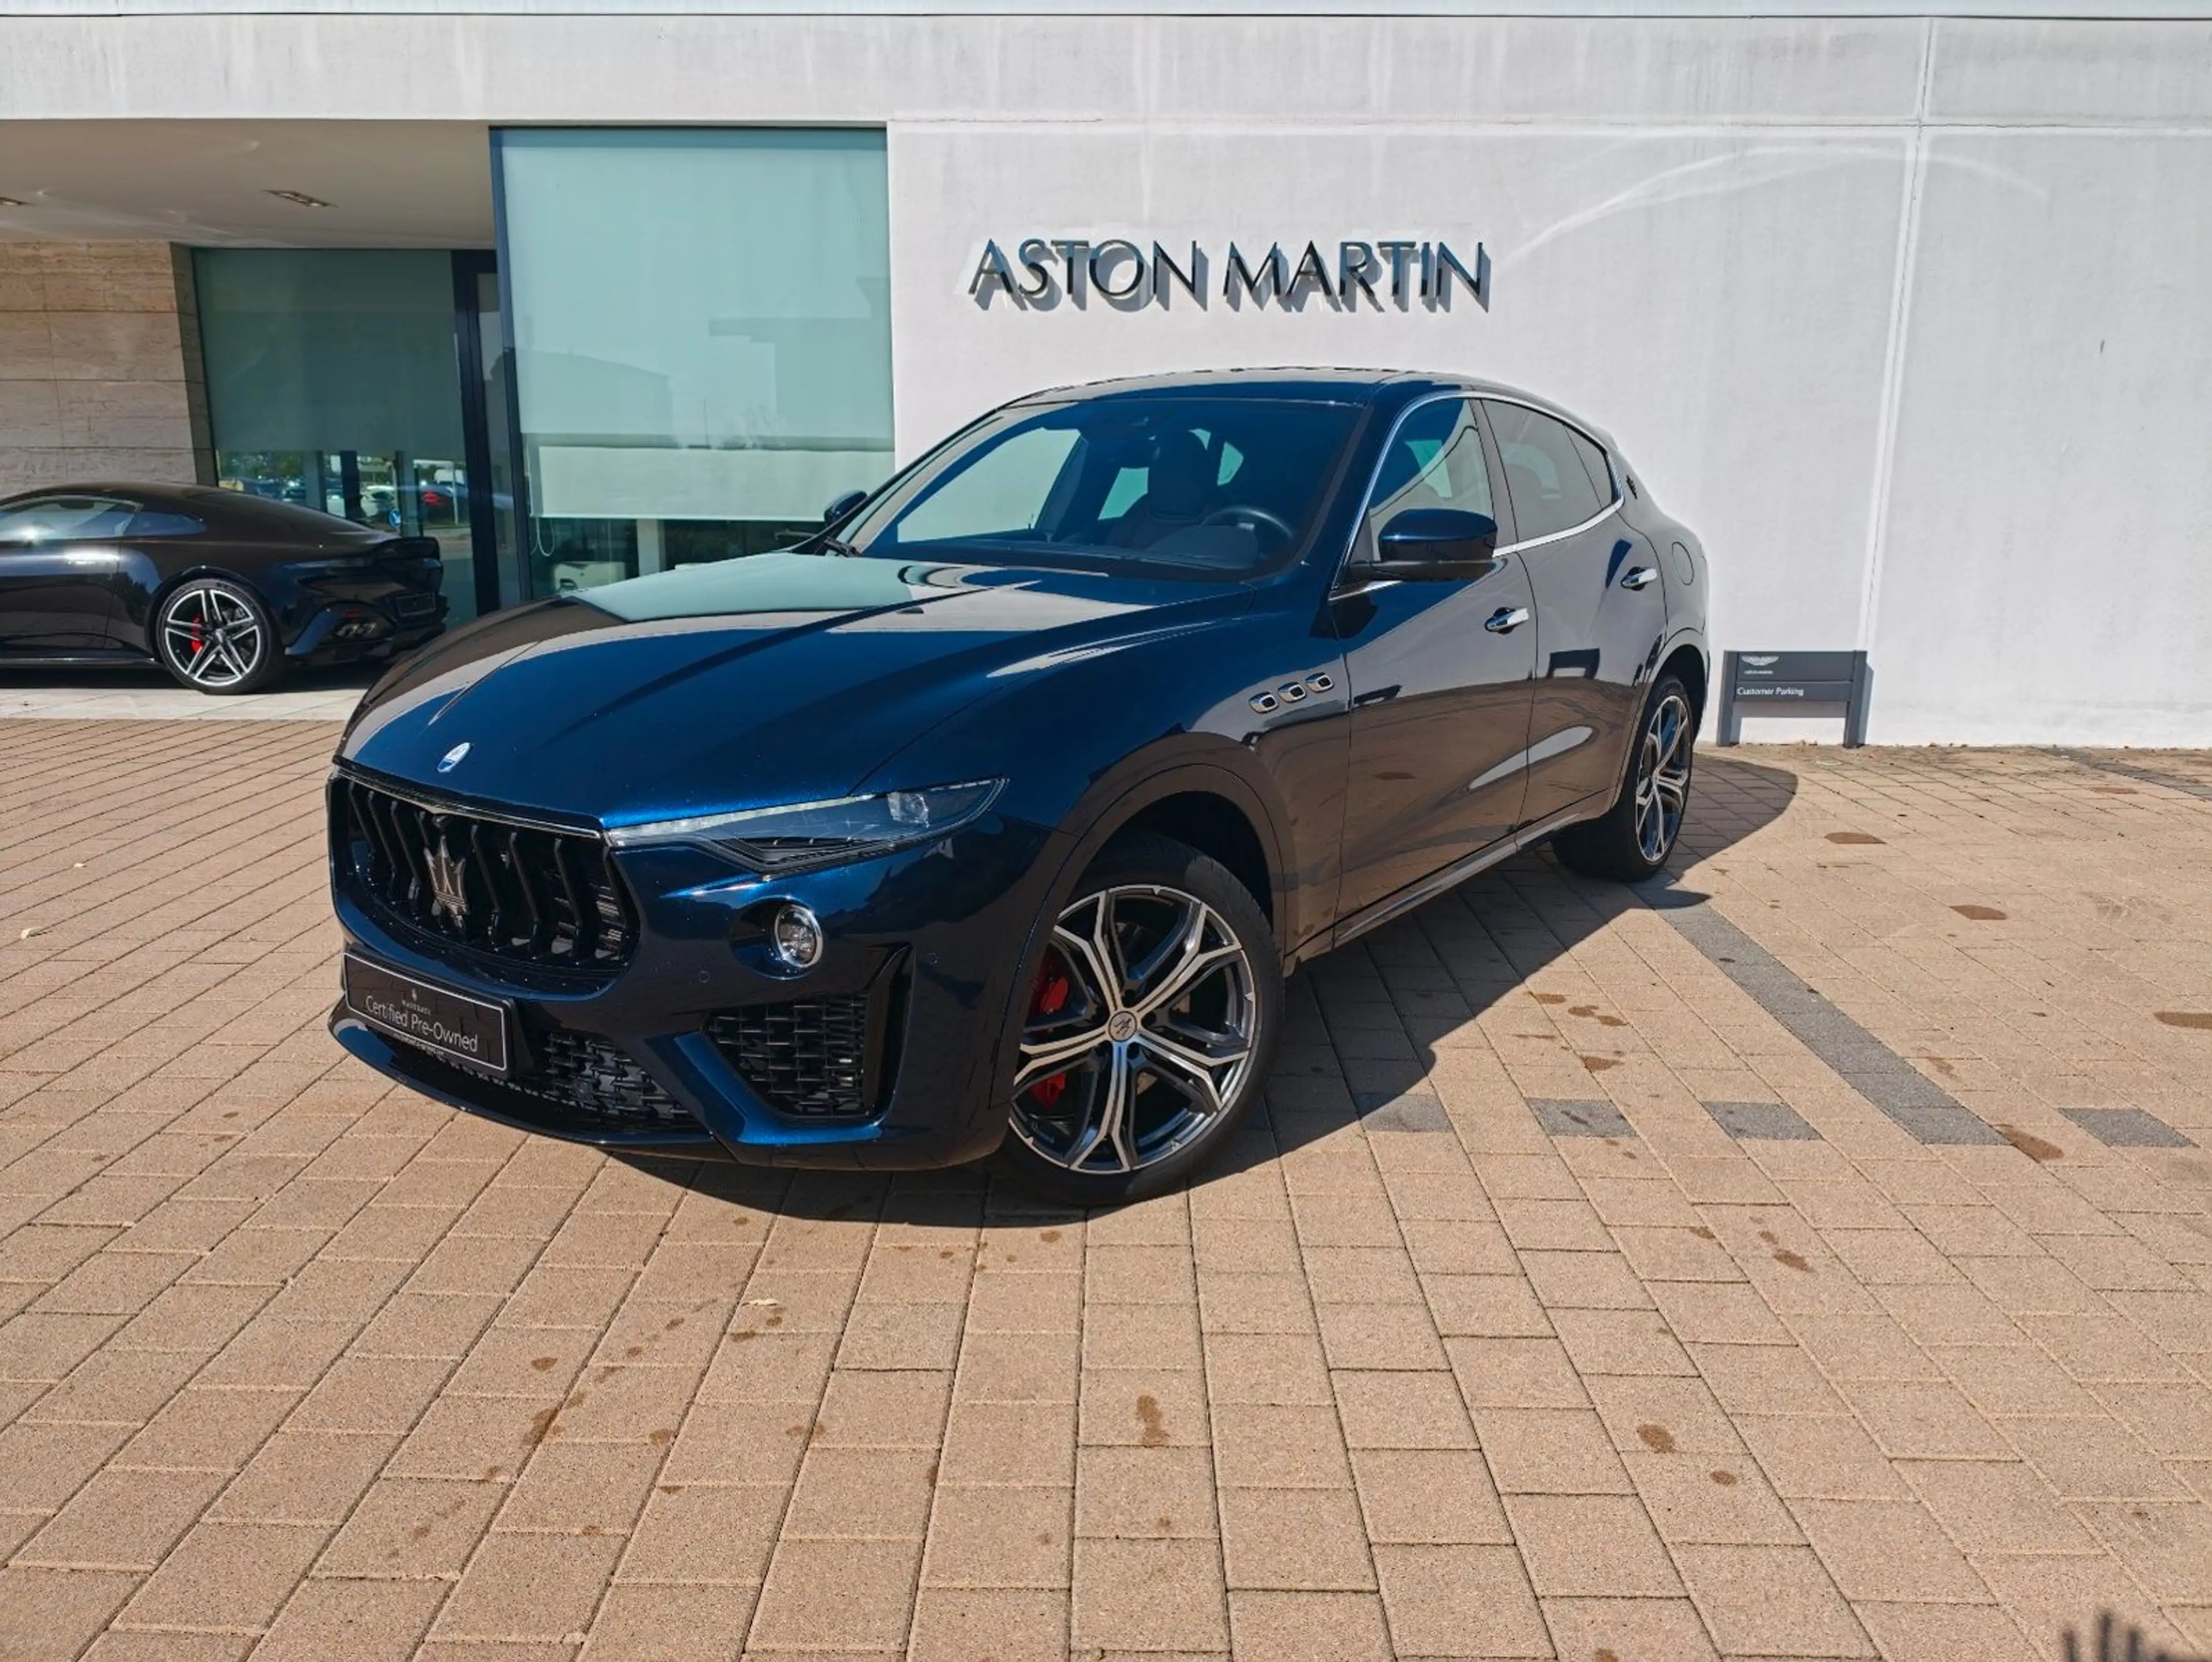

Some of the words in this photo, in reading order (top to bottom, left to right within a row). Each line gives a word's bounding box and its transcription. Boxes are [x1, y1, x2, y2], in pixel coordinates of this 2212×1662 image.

[968, 238, 1197, 297] ASTON
[1222, 239, 1484, 298] MARTIN
[1736, 687, 1774, 695] Customer
[1775, 687, 1804, 697] Parking
[365, 995, 408, 1027] Certified
[411, 1013, 478, 1053] Pre-Owned
